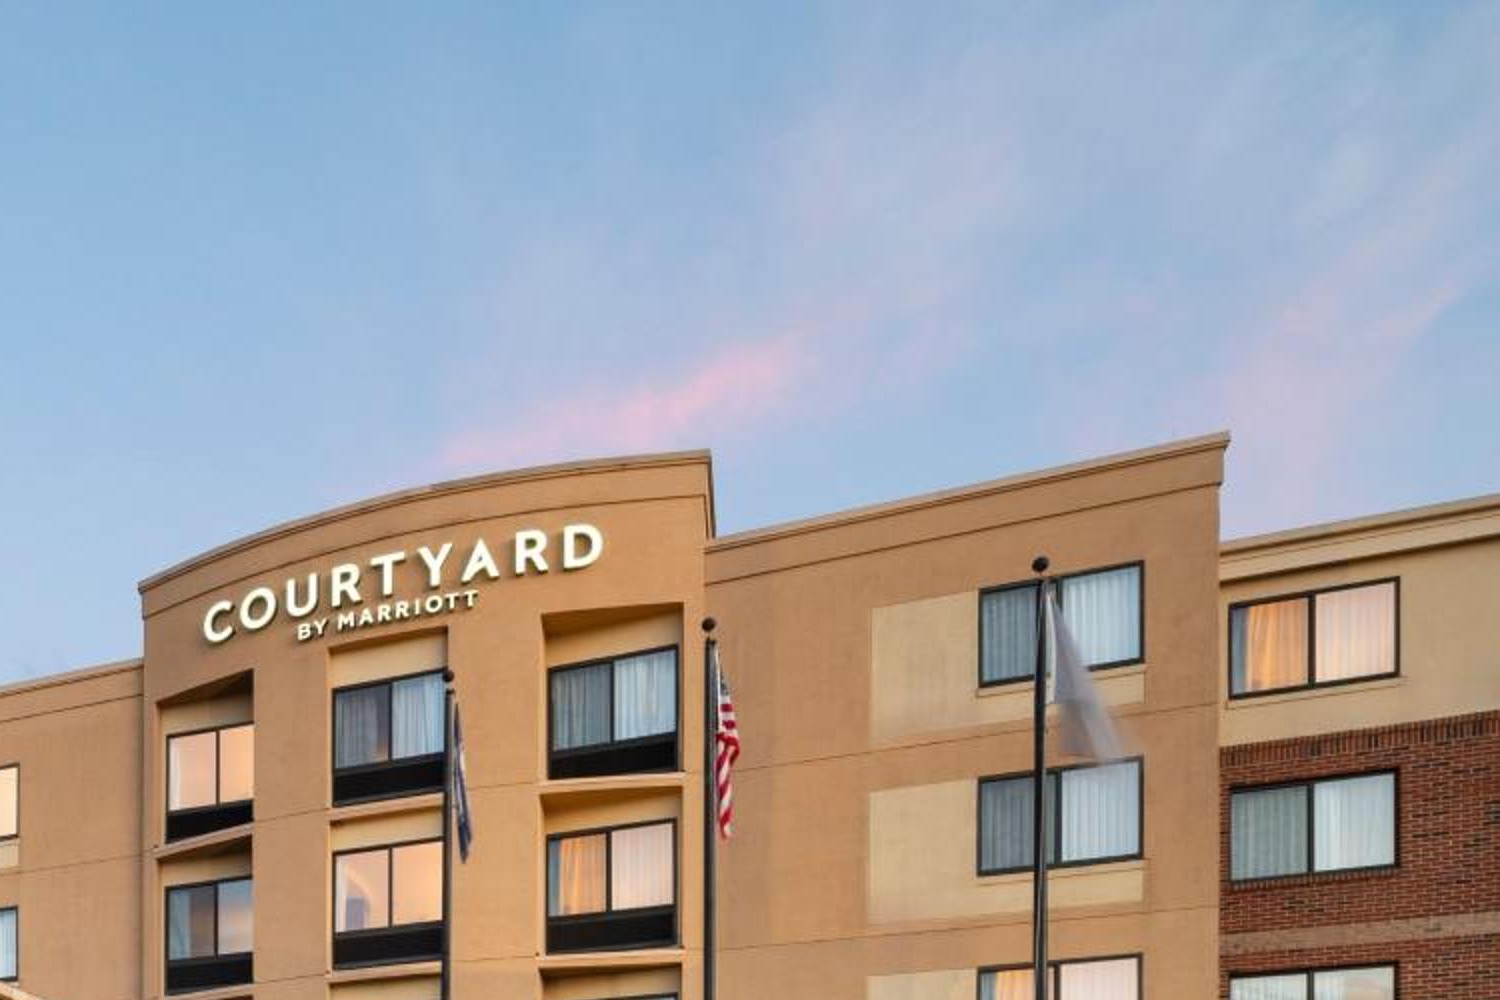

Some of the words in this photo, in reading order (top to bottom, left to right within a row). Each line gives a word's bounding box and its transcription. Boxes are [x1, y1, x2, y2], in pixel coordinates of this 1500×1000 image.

[203, 523, 604, 643] COURTYARD
[298, 619, 328, 641] BY
[337, 589, 479, 631] MARRIOTT
